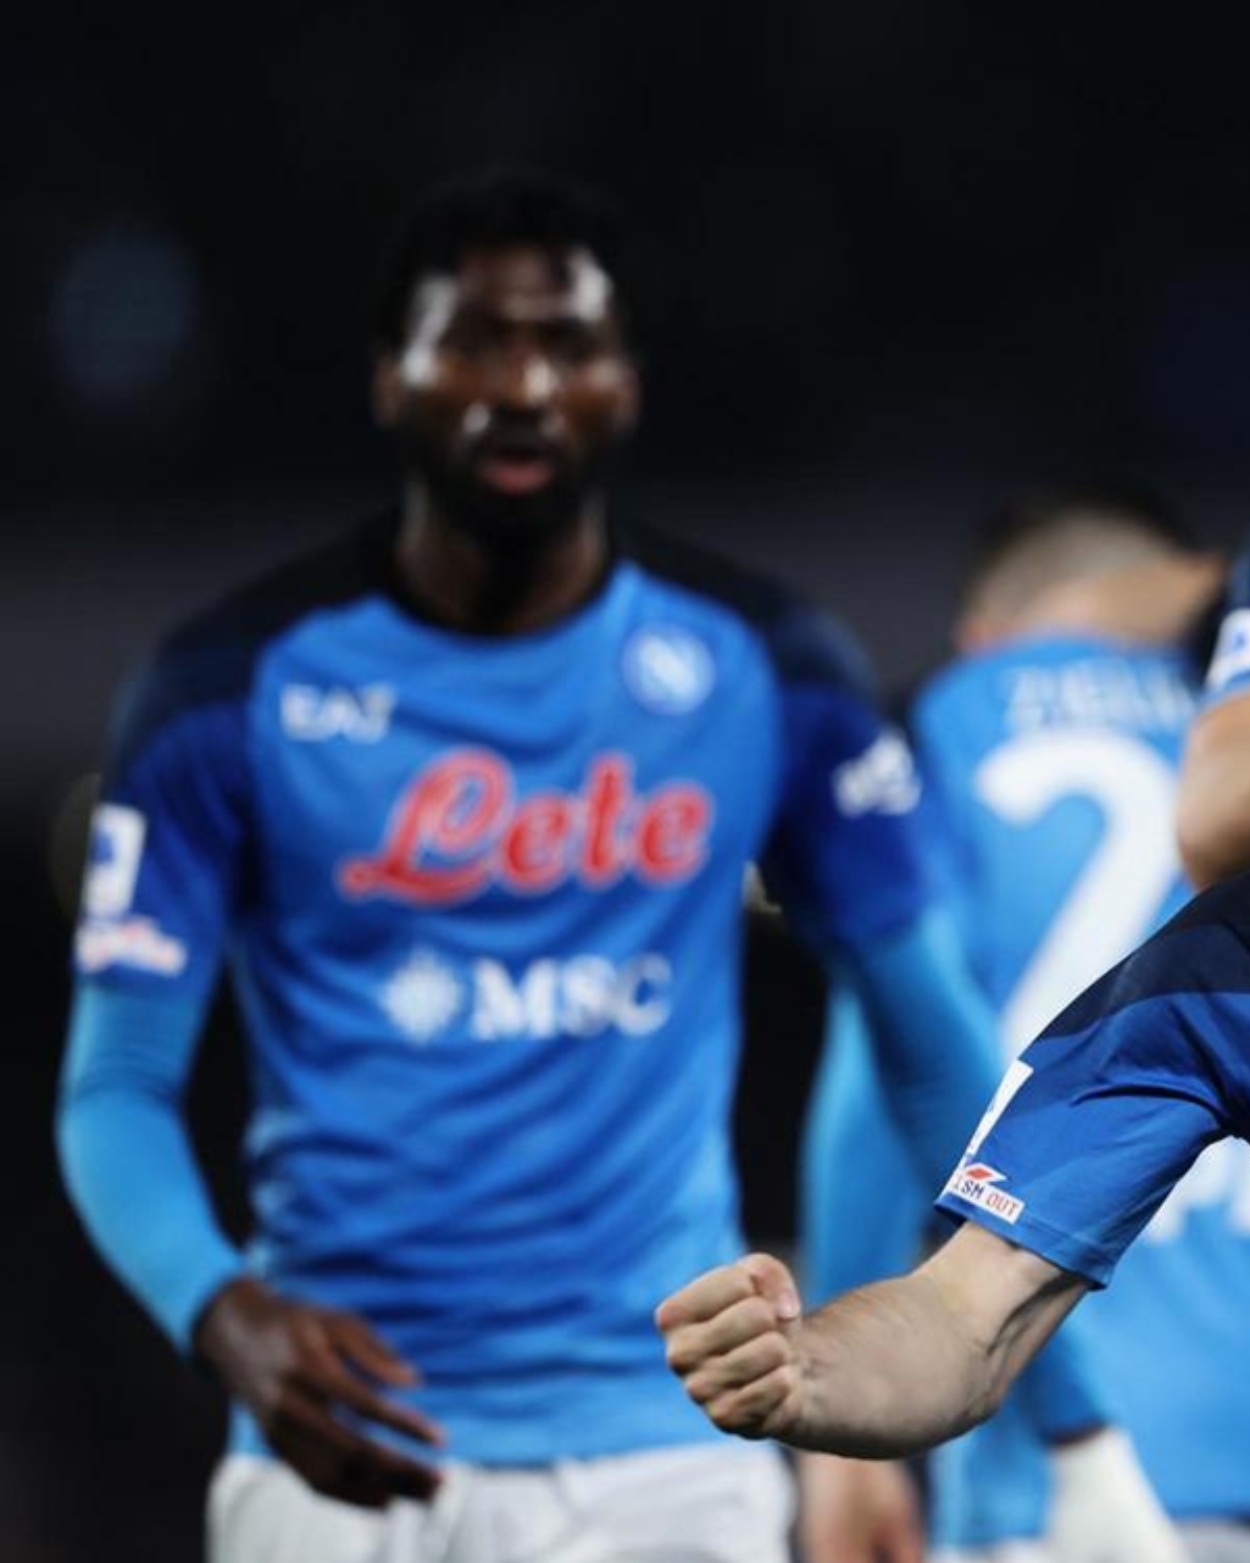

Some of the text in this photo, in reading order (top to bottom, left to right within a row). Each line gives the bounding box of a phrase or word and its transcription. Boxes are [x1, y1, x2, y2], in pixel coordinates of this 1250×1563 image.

[336, 746, 715, 908] Lete
[470, 951, 673, 1041] MSC
[986, 1191, 1019, 1217] OUT
